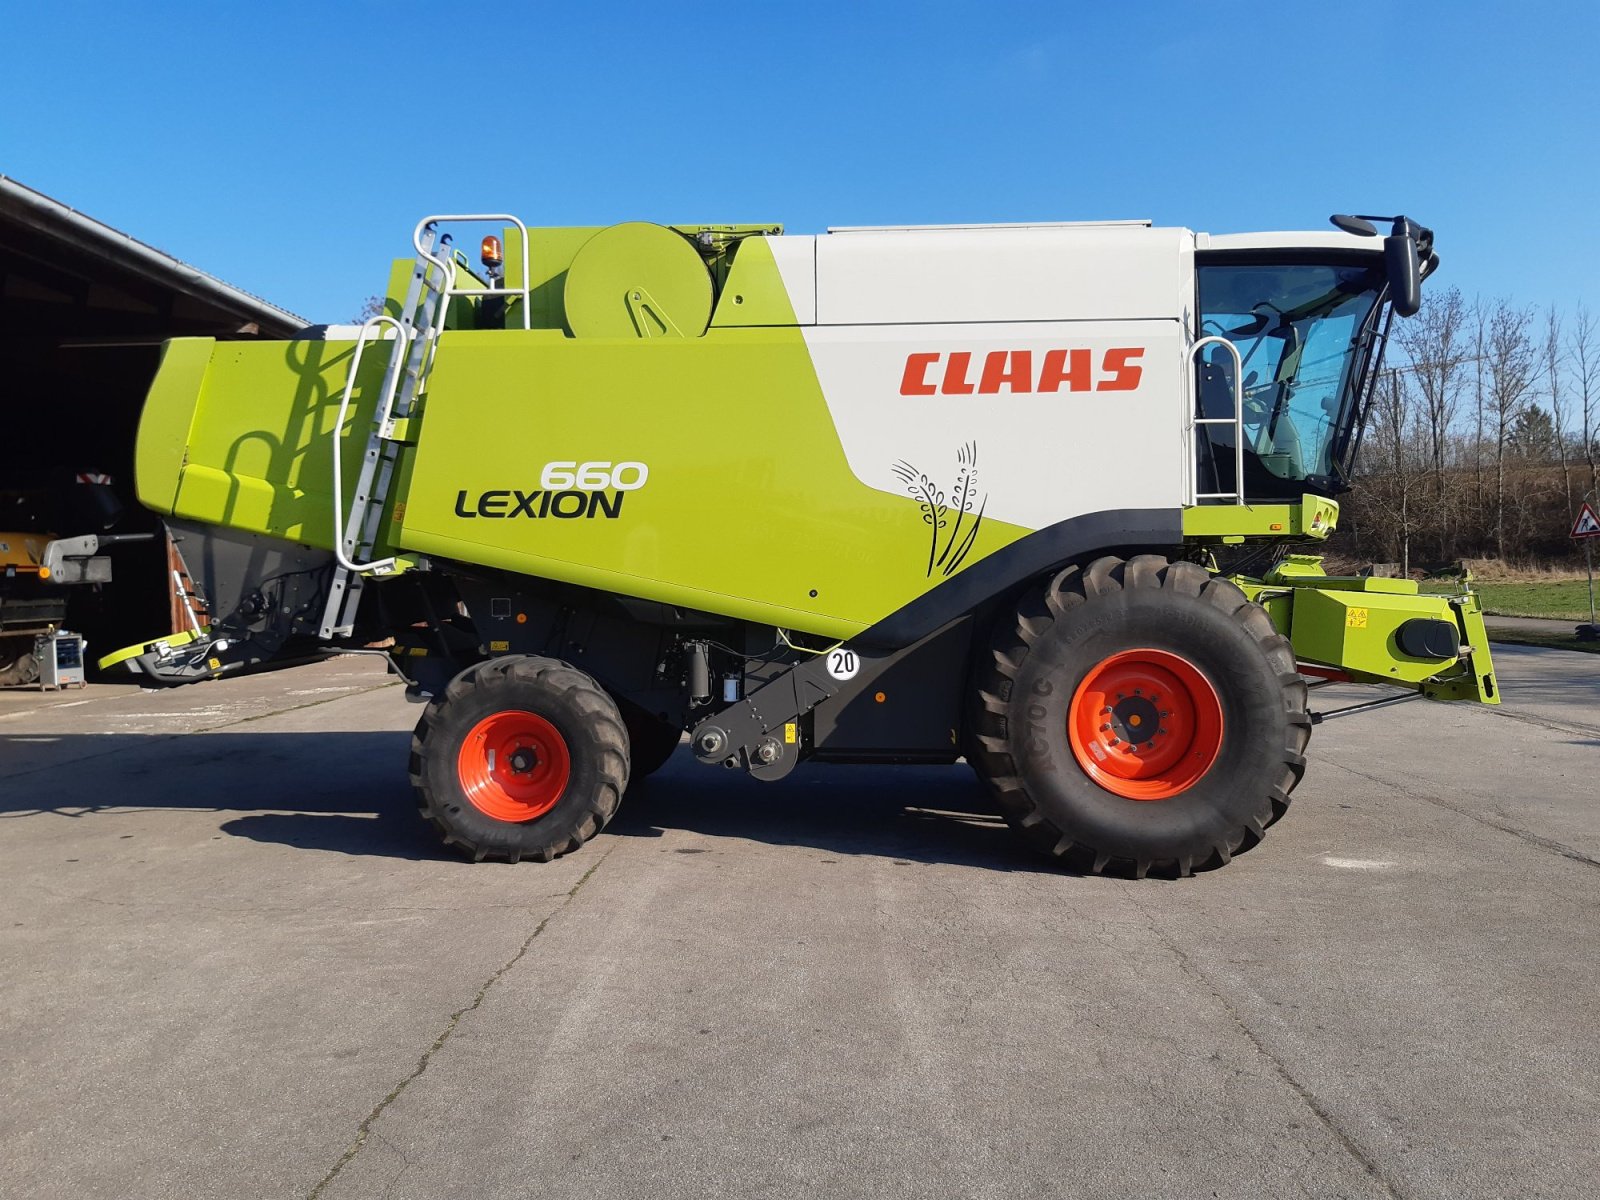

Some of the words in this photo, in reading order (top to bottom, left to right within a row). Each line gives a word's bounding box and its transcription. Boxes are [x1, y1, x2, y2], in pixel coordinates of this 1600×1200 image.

[900, 347, 1145, 396] CLAAS
[540, 461, 649, 492] 660
[454, 490, 624, 519] LEXION
[832, 651, 855, 674] 20
